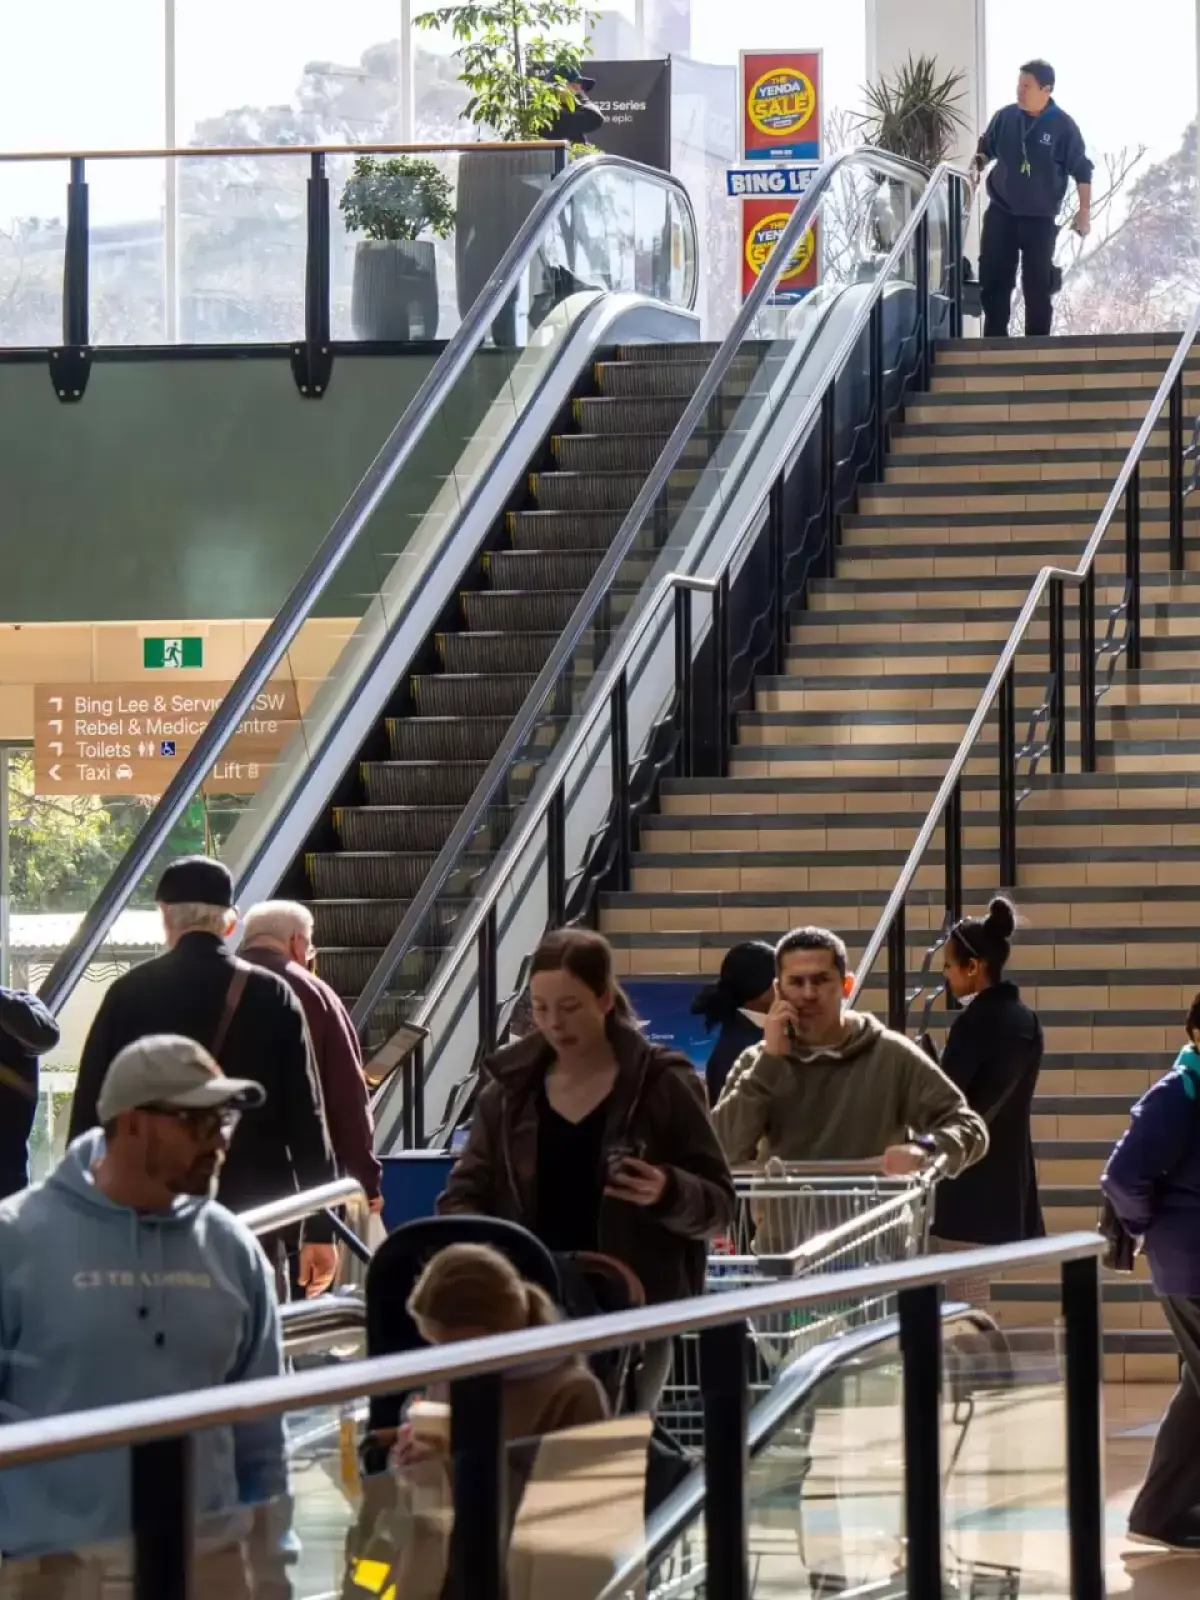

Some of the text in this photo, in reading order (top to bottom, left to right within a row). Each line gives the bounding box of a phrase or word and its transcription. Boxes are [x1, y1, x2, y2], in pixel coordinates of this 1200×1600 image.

[759, 81, 801, 97] YENDA
[612, 100, 646, 111] Series
[754, 93, 809, 118] SALE
[731, 169, 813, 194] BING LE
[75, 694, 286, 717] Bing Lee & Servic SW
[75, 719, 123, 736] Rebel
[128, 718, 142, 736] &
[146, 716, 208, 736] Medica
[74, 740, 132, 759] Toilets
[75, 762, 241, 781] Taxi Lift
